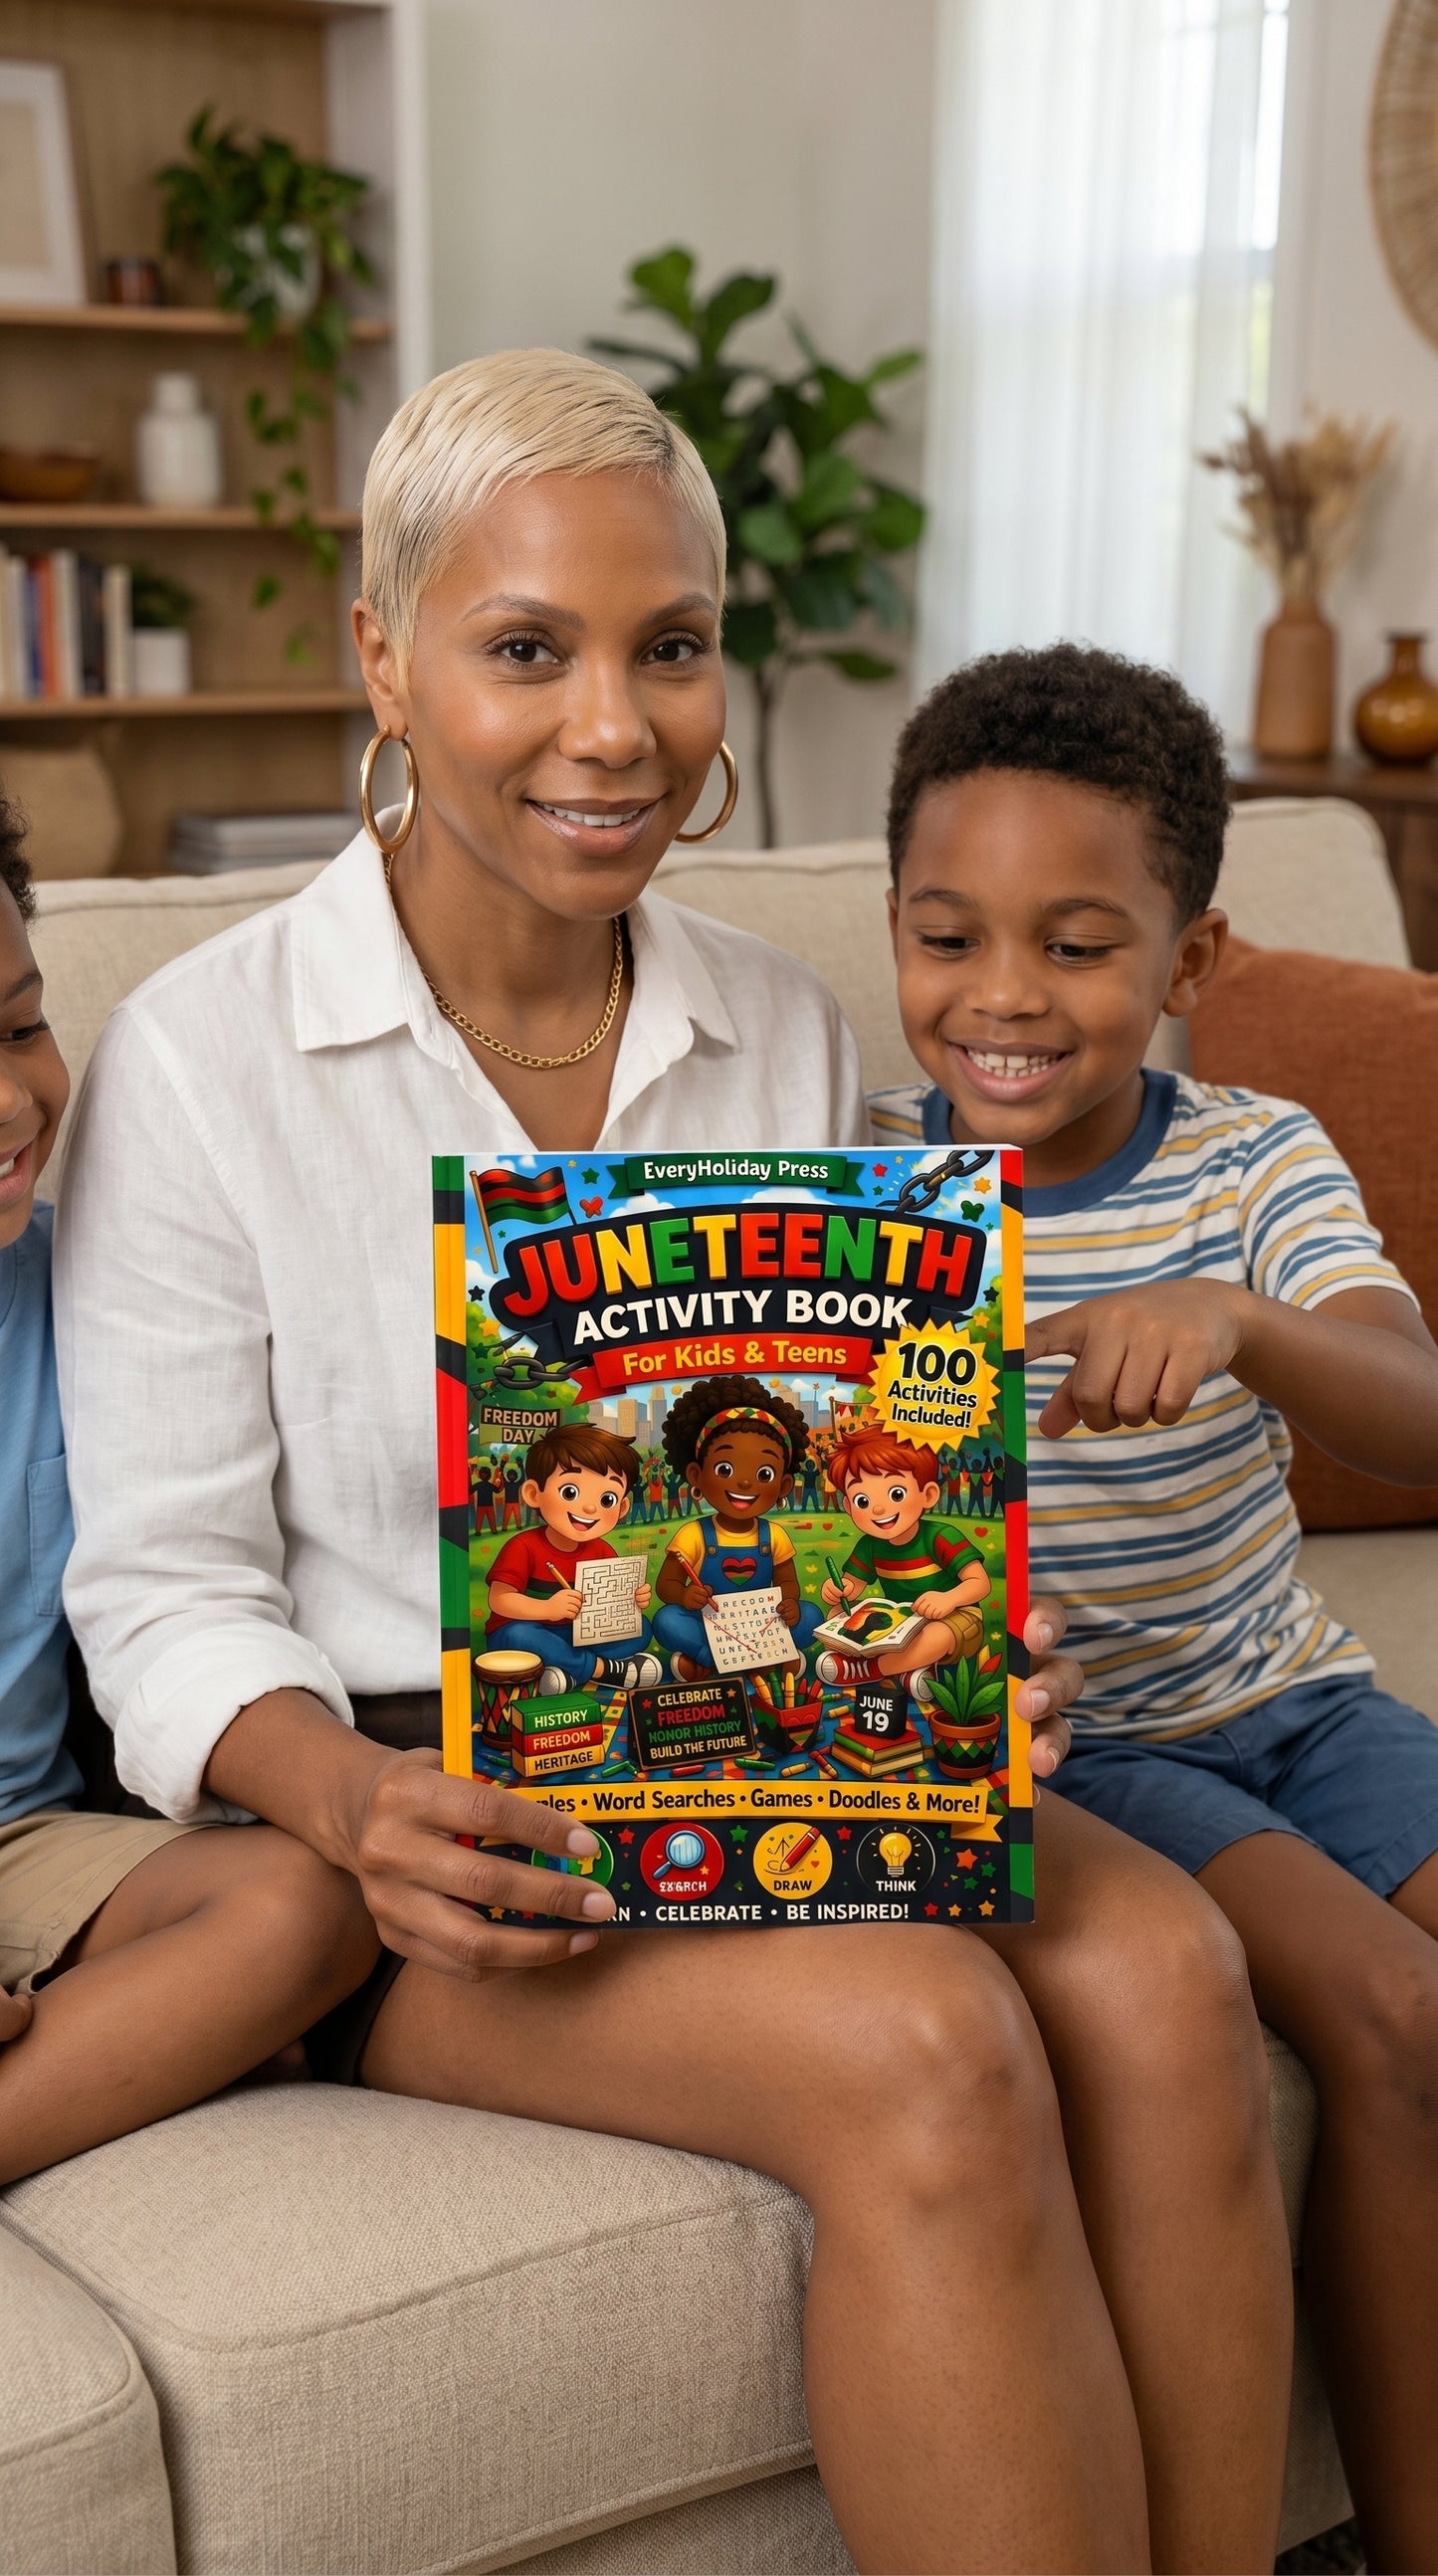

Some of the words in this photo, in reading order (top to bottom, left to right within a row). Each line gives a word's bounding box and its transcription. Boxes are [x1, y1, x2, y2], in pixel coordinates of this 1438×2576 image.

[643, 1158, 771, 1181] EveryHoliday
[778, 1160, 829, 1179] Press
[504, 1212, 973, 1317] JUNETEENTH
[573, 1289, 773, 1345] ACTIVITY
[786, 1289, 914, 1328] BOOK
[622, 1352, 667, 1376] For
[675, 1342, 735, 1369] Kids
[743, 1340, 765, 1364] &
[771, 1340, 847, 1364] Teens
[898, 1342, 977, 1385] 100
[887, 1380, 977, 1408] Activities
[483, 1407, 557, 1427] FREEDOM
[892, 1403, 971, 1428] Included!
[503, 1428, 534, 1444] DAY
[657, 1687, 722, 1706] CELEBRATE
[859, 1695, 894, 1711] JUNE
[534, 1709, 588, 1728] HISTORY
[657, 1704, 726, 1727] FREEDOM
[862, 1710, 890, 1732] 19
[695, 1720, 741, 1737] HISTORY
[532, 1730, 591, 1750] FREEDOM
[650, 1744, 683, 1760] BUILD
[684, 1740, 705, 1755] THE
[707, 1735, 747, 1751] FUTURE
[533, 1750, 594, 1771] HERITAGE
[593, 1790, 645, 1811] Word
[652, 1788, 735, 1809] Searches
[750, 1788, 813, 1808] Games
[829, 1790, 901, 1809] Doodles
[906, 1792, 921, 1811] &
[925, 1794, 980, 1813] More!
[773, 1880, 813, 1891] DRAW
[876, 1880, 917, 1891] THINK
[656, 1904, 762, 1921] CELEBRATE
[786, 1904, 811, 1920] BE
[817, 1903, 910, 1920] INSPIRED!
